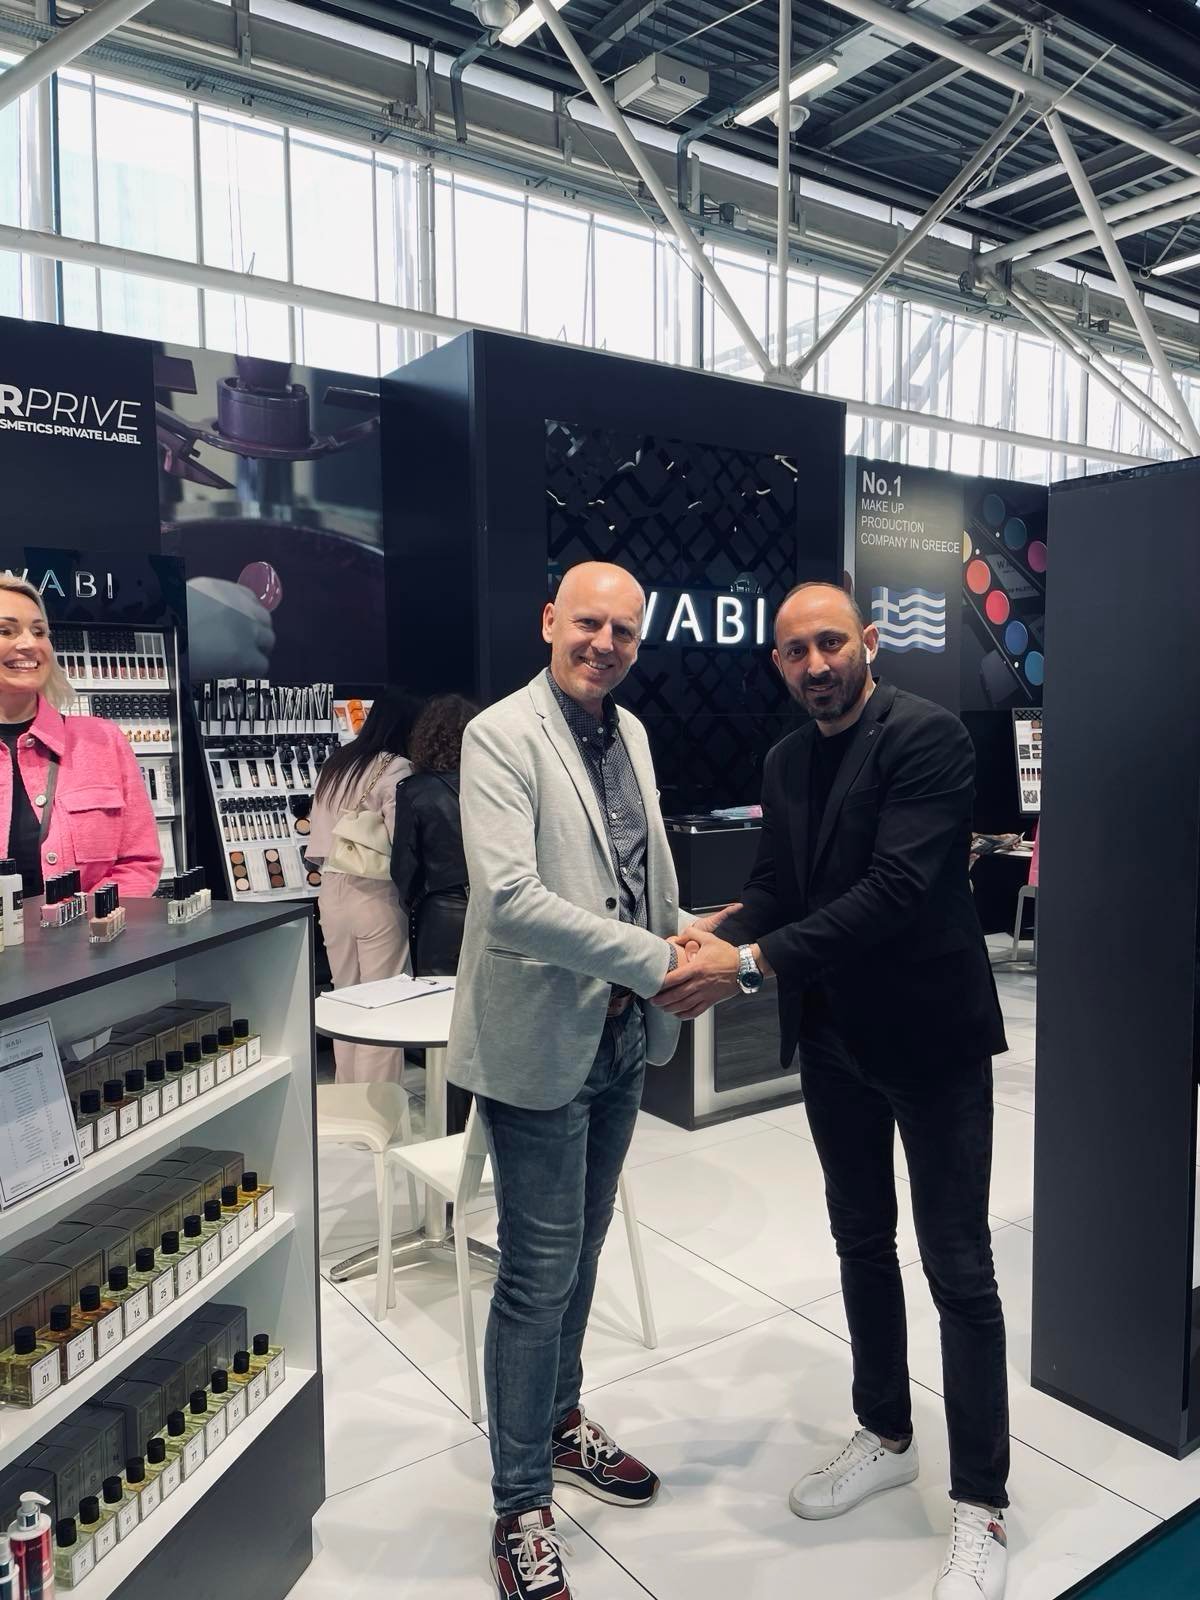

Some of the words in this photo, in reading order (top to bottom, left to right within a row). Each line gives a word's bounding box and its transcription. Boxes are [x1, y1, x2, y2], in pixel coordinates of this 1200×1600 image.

[54, 424, 102, 441] PRIVATE
[103, 431, 141, 445] LABEL
[863, 470, 901, 497] No.1
[861, 498, 888, 513] MAKE
[891, 502, 904, 514] UP
[861, 515, 925, 534] PRODUCTION
[860, 533, 908, 549] COMPANY
[910, 541, 919, 550] IN
[921, 539, 960, 554] GREECE
[77, 1349, 85, 1361] 03
[42, 1372, 49, 1384] 01
